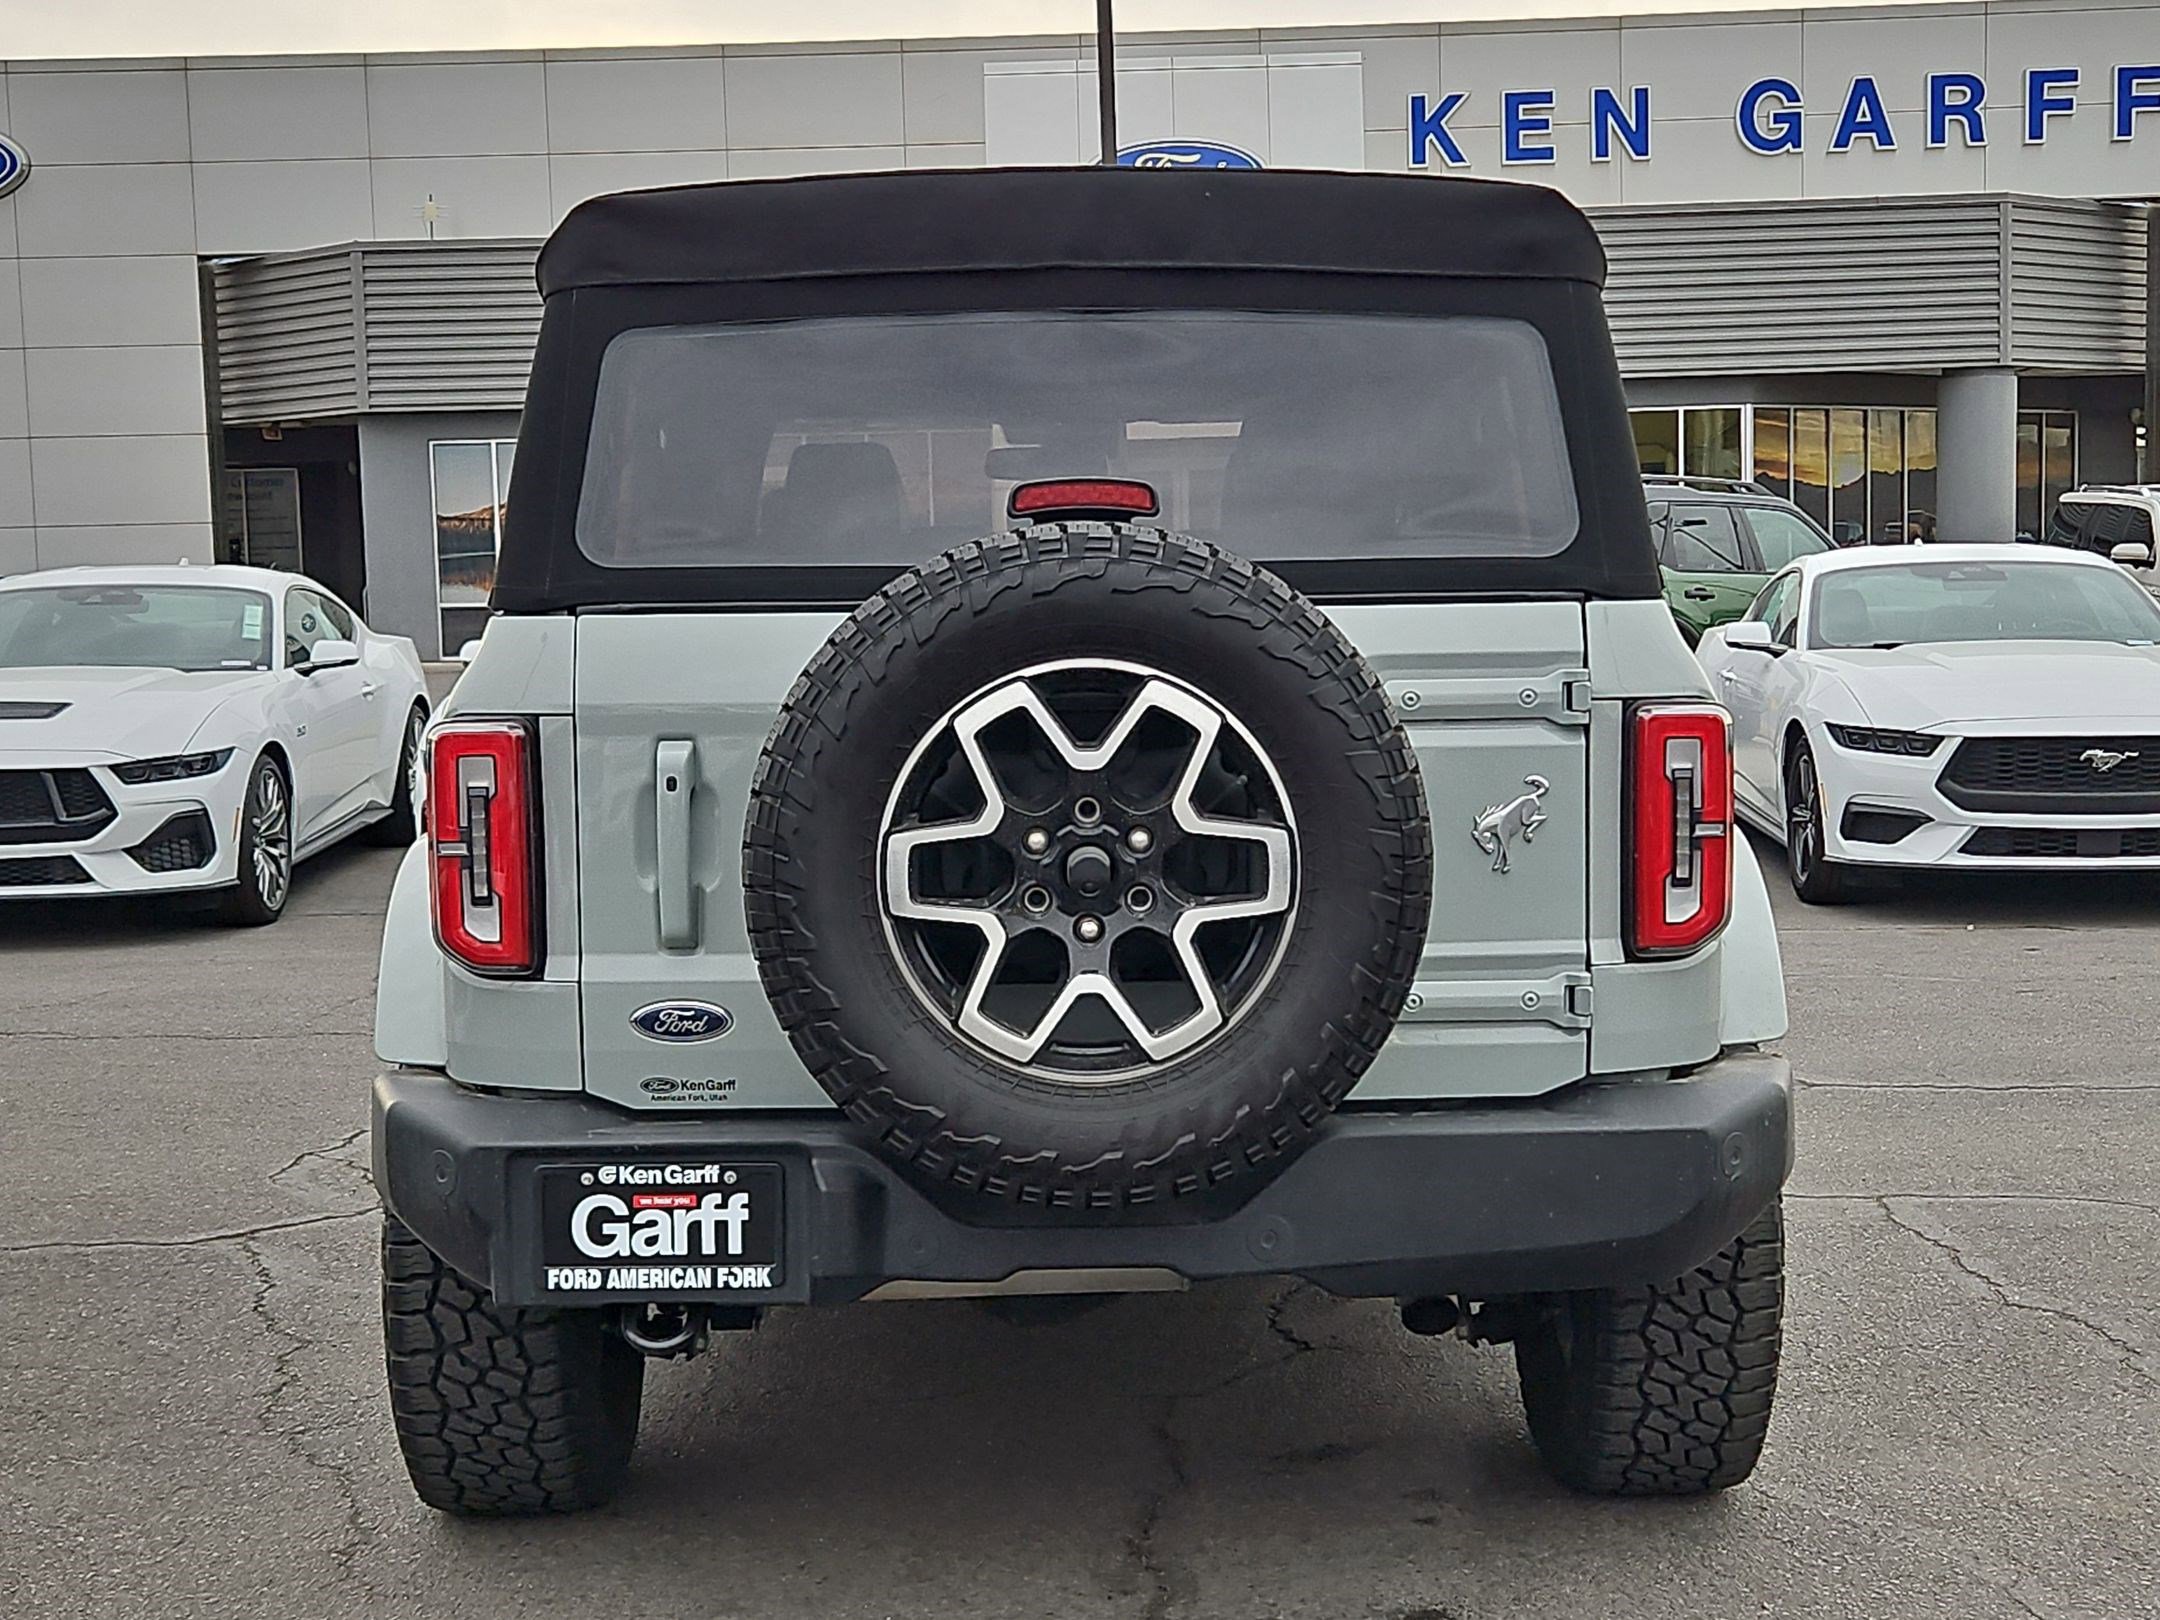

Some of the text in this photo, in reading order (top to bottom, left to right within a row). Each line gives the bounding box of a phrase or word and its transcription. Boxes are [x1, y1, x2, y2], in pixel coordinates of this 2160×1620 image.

[1406, 63, 2160, 169] KEN GARFF
[654, 1009, 709, 1033] Ford
[650, 1094, 686, 1102] American
[619, 1165, 720, 1185] Ken Garff
[571, 1192, 749, 1258] Garff
[547, 1266, 772, 1290] FORD AMERICAN FORK
